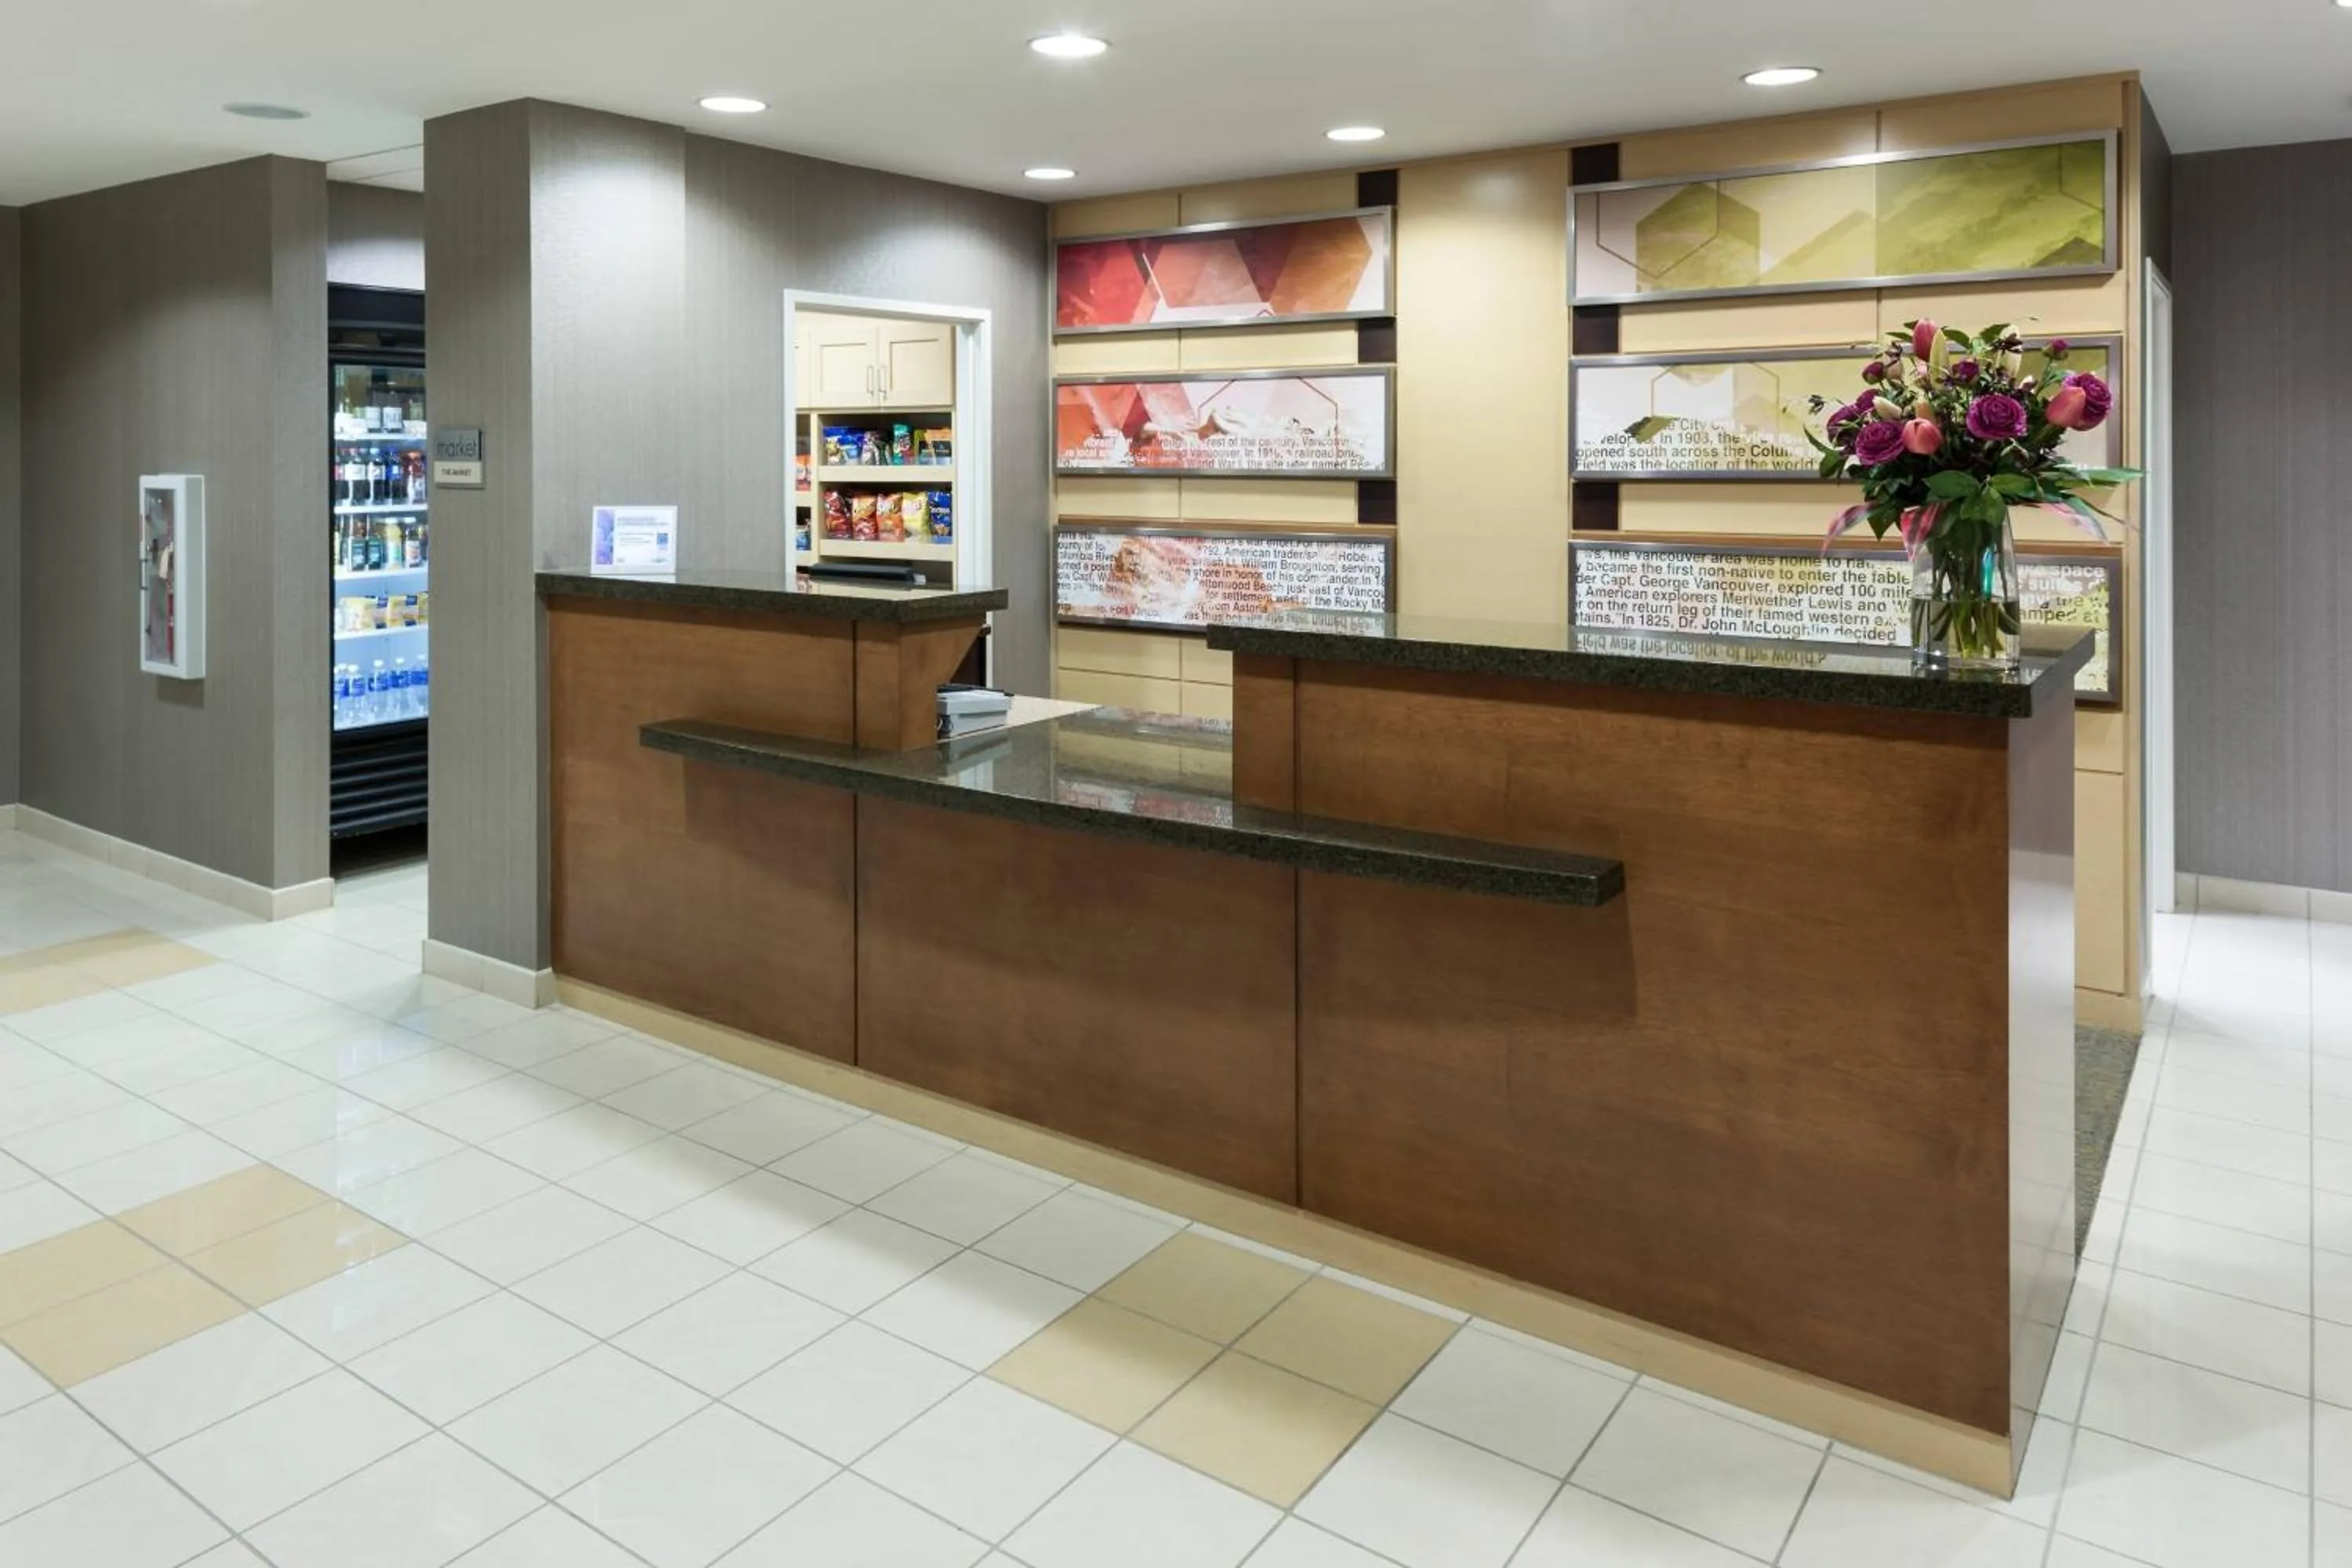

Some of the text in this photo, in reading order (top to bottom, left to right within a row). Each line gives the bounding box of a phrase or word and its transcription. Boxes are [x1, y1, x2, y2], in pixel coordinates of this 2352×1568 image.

[1661, 433, 1672, 444] In
[1718, 431, 1740, 444] the
[437, 434, 477, 456] market
[1576, 448, 1625, 459] opened
[1628, 446, 1667, 458] south
[1671, 448, 1719, 458] across
[1724, 445, 1746, 457] the
[1575, 459, 1606, 470] Field
[1610, 460, 1636, 470] was
[1641, 459, 1661, 470] the
[1726, 459, 1739, 470] of
[1742, 459, 1766, 470] the
[1224, 547, 1270, 558] American
[1711, 554, 1741, 564] area
[1747, 555, 1774, 566] was
[1266, 571, 1276, 580] of
[1279, 571, 1294, 581] his
[1341, 564, 1381, 576] serving
[1586, 561, 1638, 573] became
[1642, 563, 1663, 575] the
[1667, 562, 1694, 576] first
[1699, 566, 1775, 579] non-native
[1780, 569, 1794, 580] to
[1798, 570, 1838, 583] enter
[1842, 571, 1867, 583] the
[1287, 584, 1307, 595] just
[1334, 585, 1345, 596] of
[1600, 573, 1635, 588] Capt.
[1639, 575, 1690, 591] George
[1693, 578, 1773, 593] Vancouver,
[1777, 582, 1844, 597] explored
[1850, 584, 1876, 597] 100
[1315, 596, 1332, 607] the
[1335, 596, 1368, 610] Rocky
[1586, 586, 1647, 600] American
[1652, 589, 1718, 603] explorers
[1722, 592, 1803, 608] Meriwether
[1809, 595, 1853, 610] Lewis
[1857, 598, 1887, 612] and
[1587, 601, 1603, 611] on
[1607, 599, 1628, 612] the
[1632, 602, 1672, 615] return
[1677, 603, 1697, 618] leg
[1702, 605, 1715, 617] of
[1721, 606, 1753, 618] their
[1758, 608, 1803, 622] famed
[1809, 612, 1869, 625] western
[1639, 614, 1674, 628] 1825,
[1679, 615, 1698, 630] Dr.
[1702, 618, 1737, 631] John
[1835, 626, 1896, 641] decided
